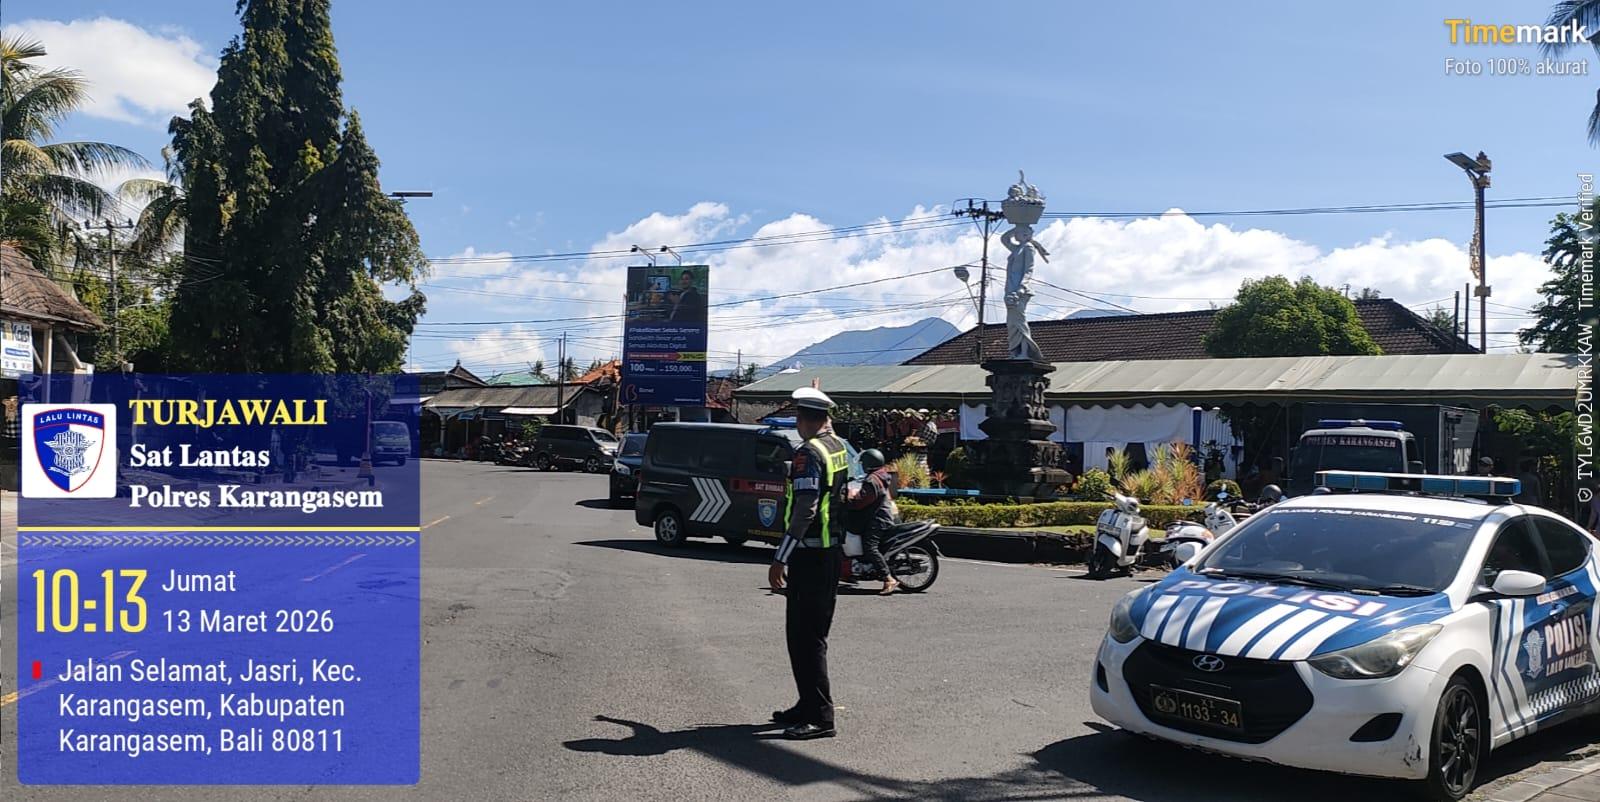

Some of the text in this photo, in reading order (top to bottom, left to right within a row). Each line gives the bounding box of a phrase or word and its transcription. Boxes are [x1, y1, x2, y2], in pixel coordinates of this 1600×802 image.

[630, 363, 645, 372] 100
[1338, 437, 1397, 448] KARANGASEM
[1164, 579, 1388, 617] POLISI
[1544, 613, 1588, 659] POLISI
[1546, 659, 1563, 677] LALU
